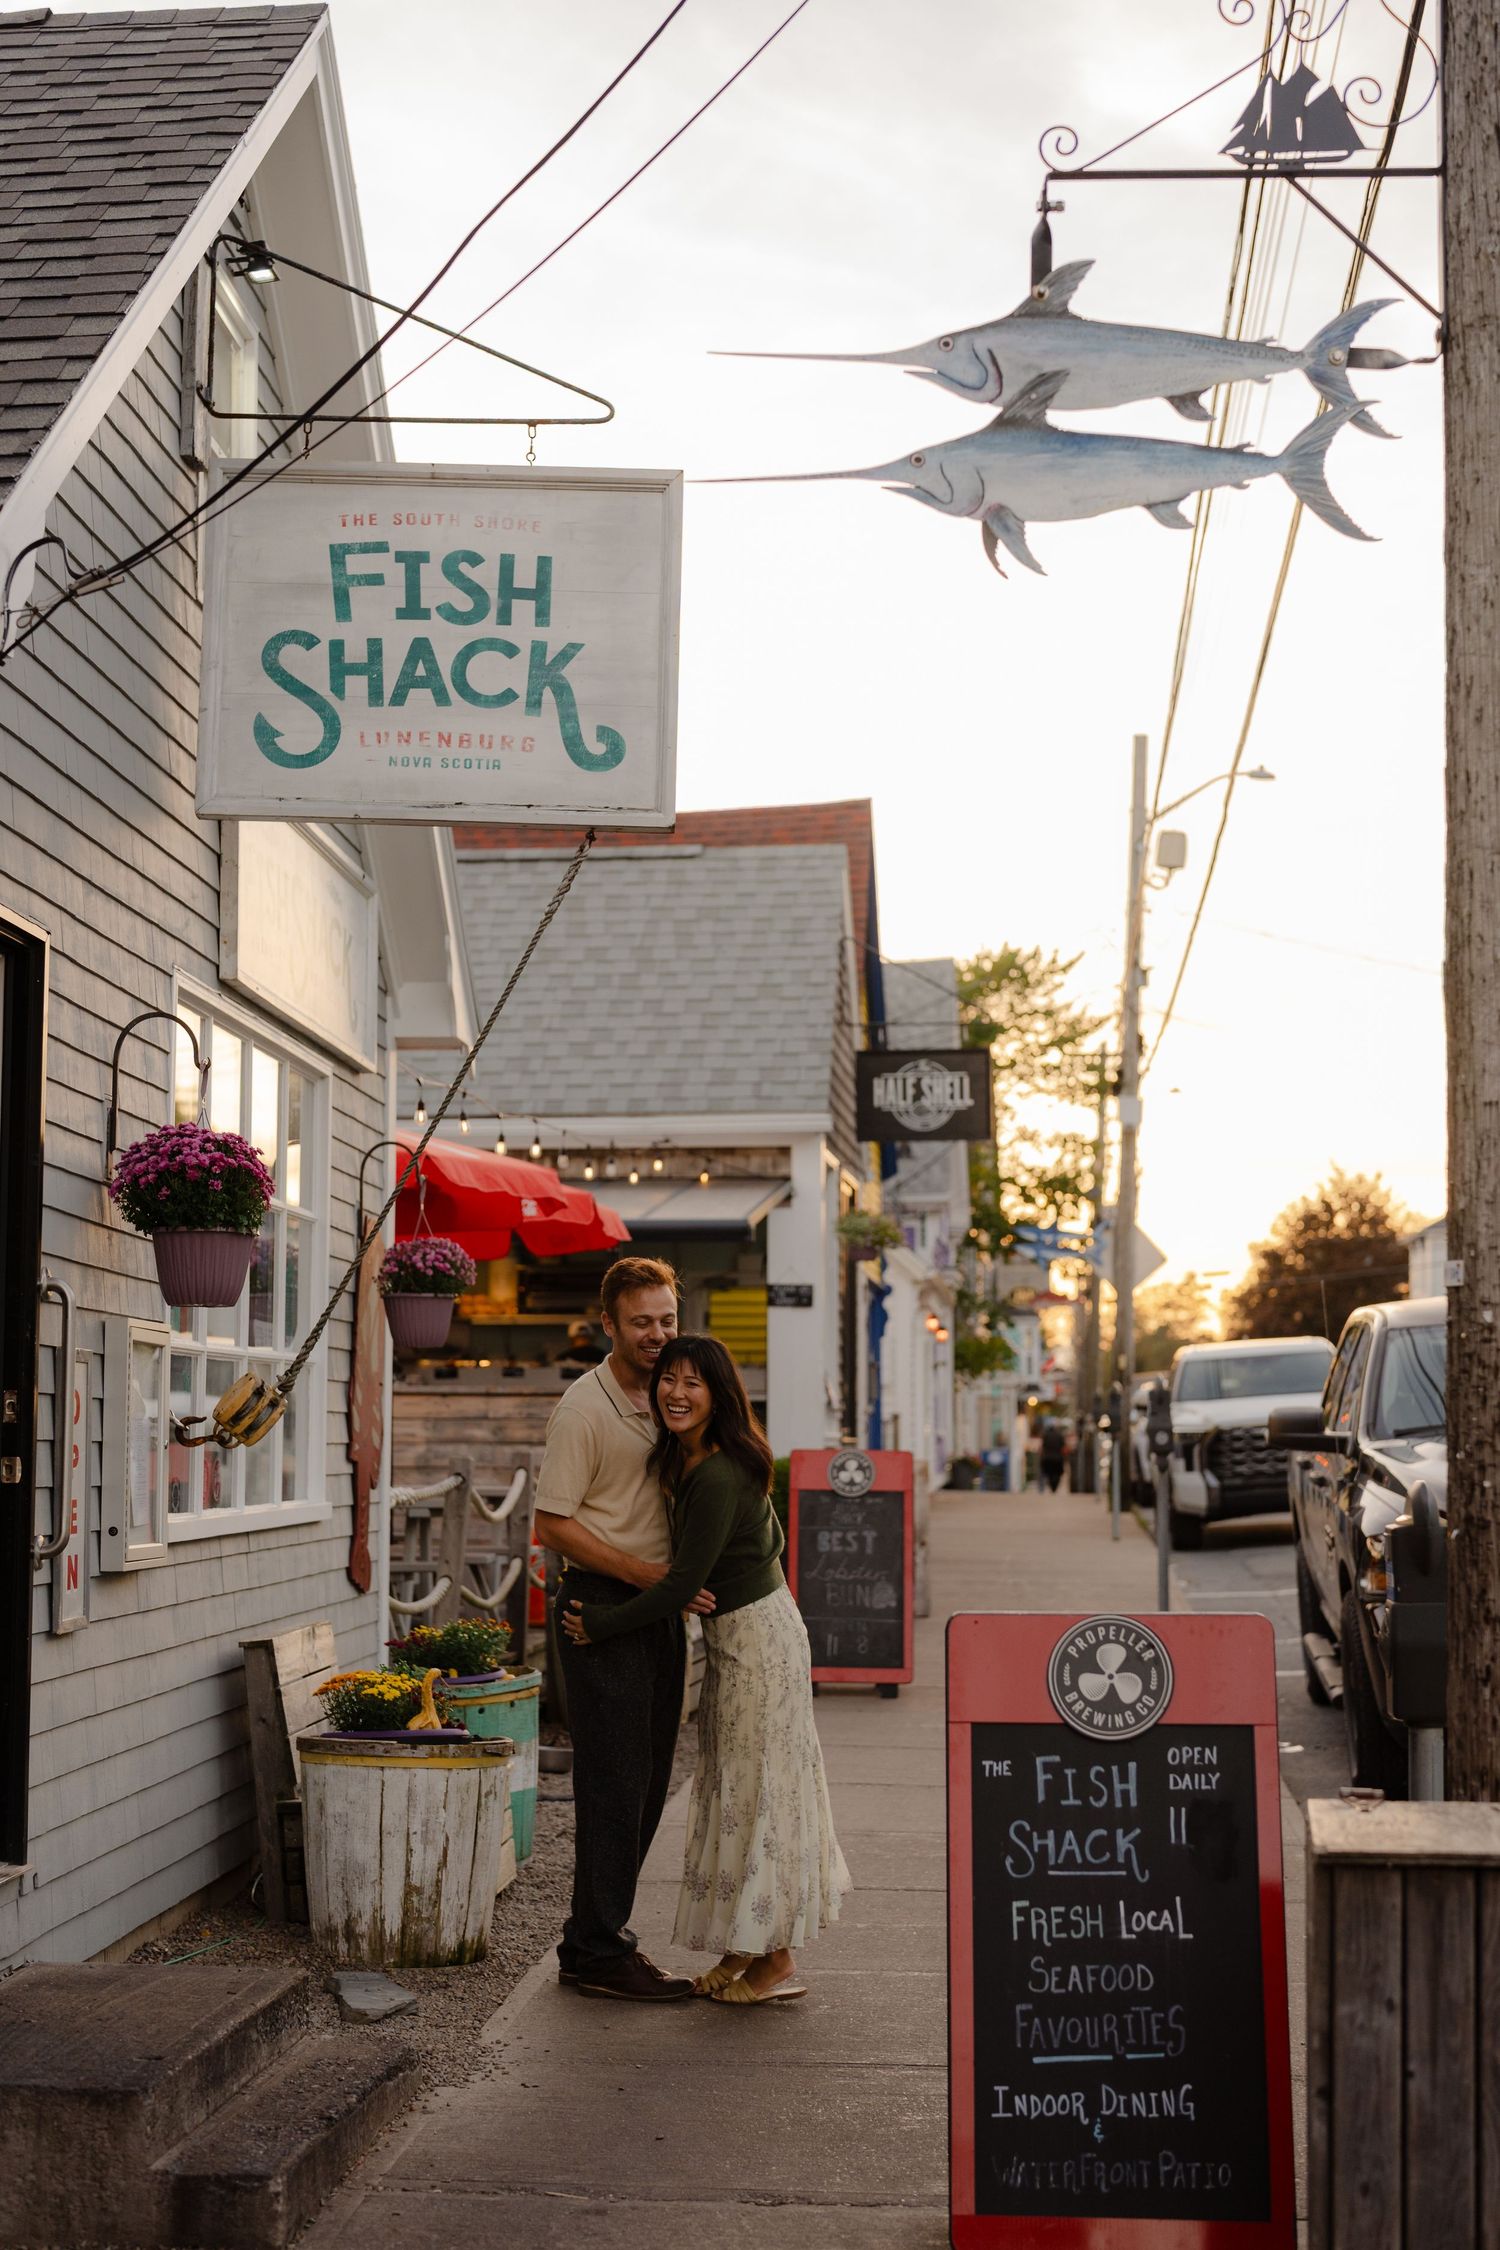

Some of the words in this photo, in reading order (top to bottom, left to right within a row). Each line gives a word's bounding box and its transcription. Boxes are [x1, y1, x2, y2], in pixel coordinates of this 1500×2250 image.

[339, 513, 378, 528] THE
[393, 512, 461, 527] SOUTH
[474, 514, 542, 533] SHORE
[329, 541, 553, 628] FISH
[253, 630, 626, 773] SHACK
[359, 730, 536, 753] LUNENBURG
[388, 755, 432, 768] NOVA
[440, 756, 502, 770] SCOTIA
[817, 1530, 877, 1554] BEST
[1067, 1625, 1155, 1661] PROPELLER
[1065, 1691, 1135, 1728] BREWING
[1136, 1695, 1156, 1715] CO
[1167, 1746, 1218, 1765] OPEN
[982, 1760, 1012, 1777] THE
[1035, 1755, 1138, 1808] FISH
[1169, 1772, 1221, 1790] DAILY
[1005, 1820, 1149, 1882] SHACK
[1012, 1900, 1104, 1946] FRESH
[1119, 1896, 1194, 1939] LOCAL
[1028, 1956, 1154, 1993] SEAFOOD
[1016, 2003, 1186, 2056] FAVOURITES
[992, 2085, 1089, 2125] INDOOR
[1101, 2084, 1196, 2121] DINING
[1159, 2150, 1232, 2190] PATIO
